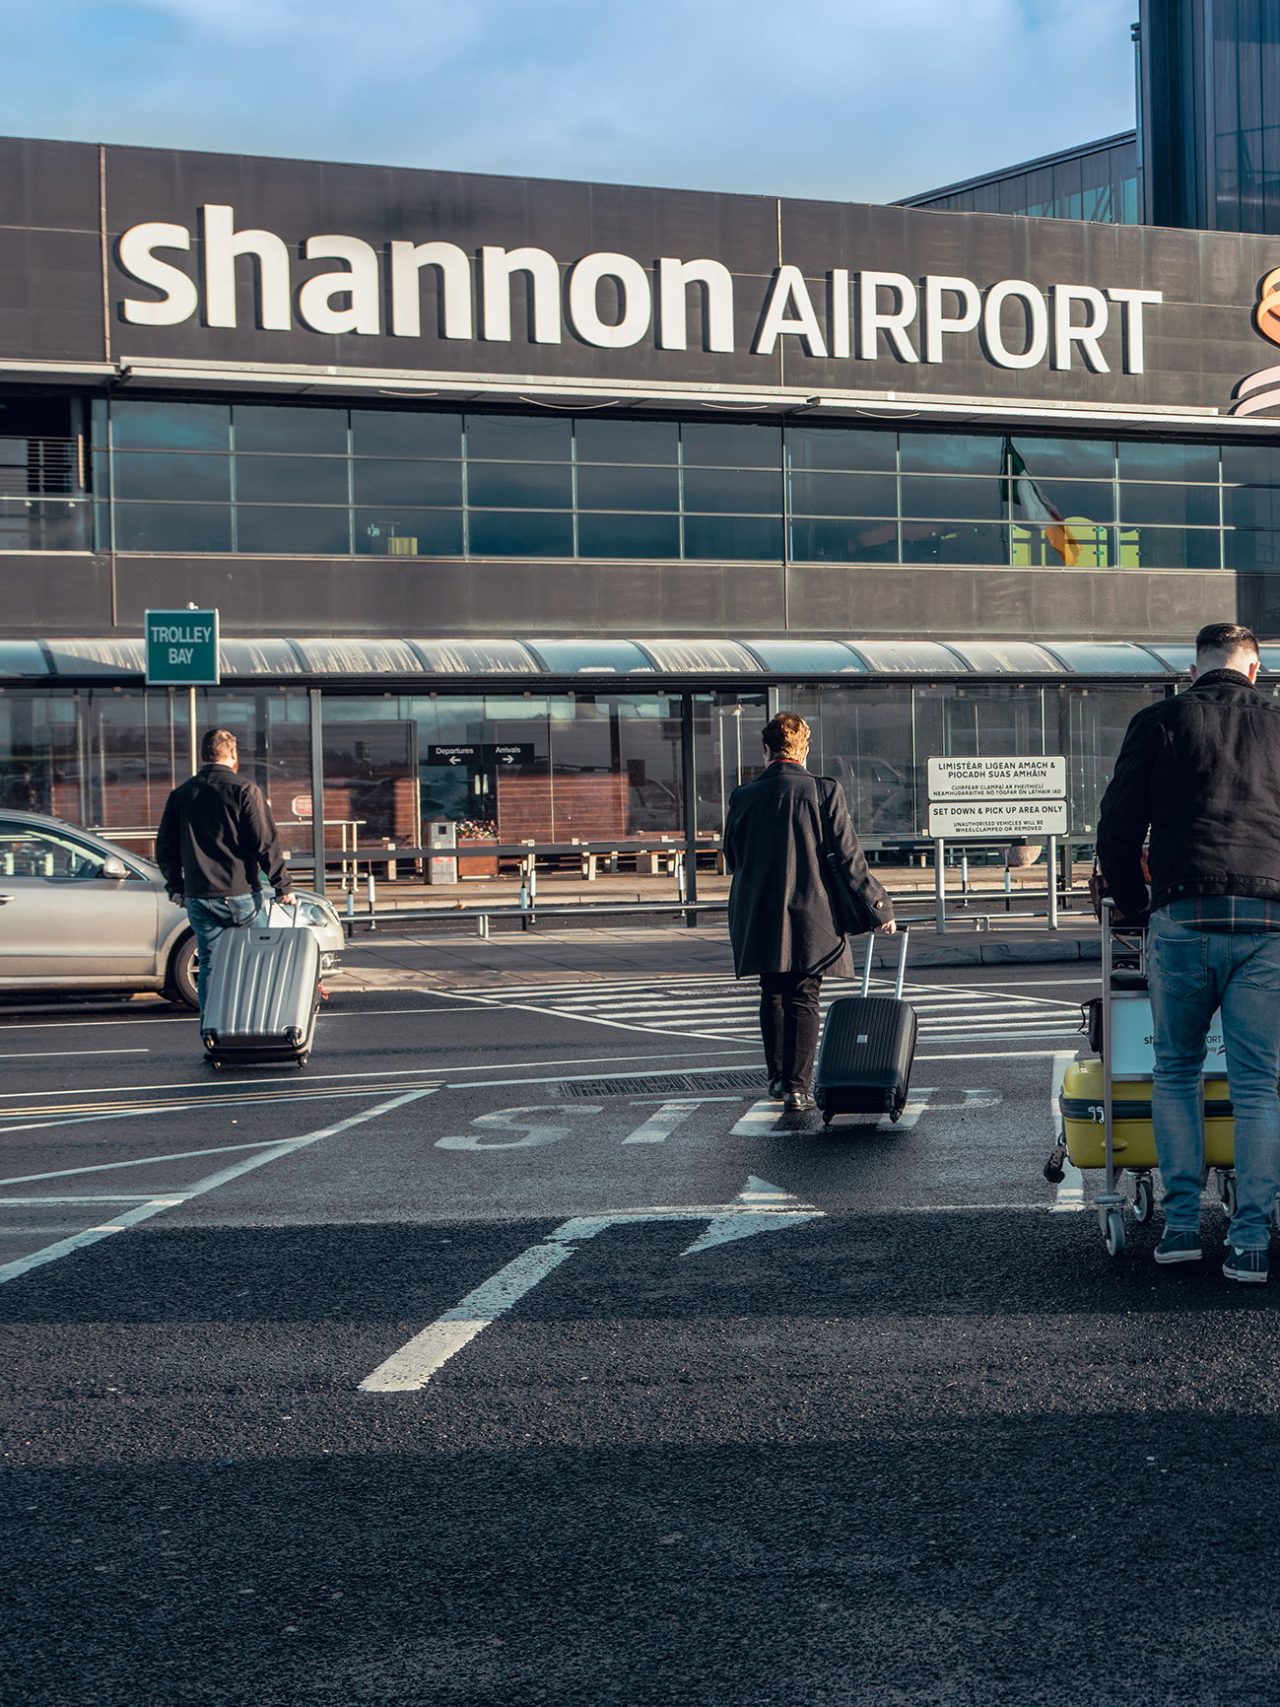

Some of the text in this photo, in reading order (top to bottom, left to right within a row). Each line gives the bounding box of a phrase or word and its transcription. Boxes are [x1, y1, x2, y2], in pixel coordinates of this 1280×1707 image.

[119, 203, 1163, 374] shannon AIRPORT
[150, 626, 212, 643] TROLLEY
[168, 648, 194, 665] BAY
[435, 747, 474, 755] Departures
[495, 746, 521, 754] Arrivals
[938, 761, 983, 771] LIMISTÉAR
[985, 762, 1016, 770] LIGEAN
[1018, 761, 1048, 769] AMACH
[948, 769, 1047, 779] PIOCADH SUAS AMHÁIN
[933, 805, 1063, 816] SET DOWN & PICK UP AREA ONLY
